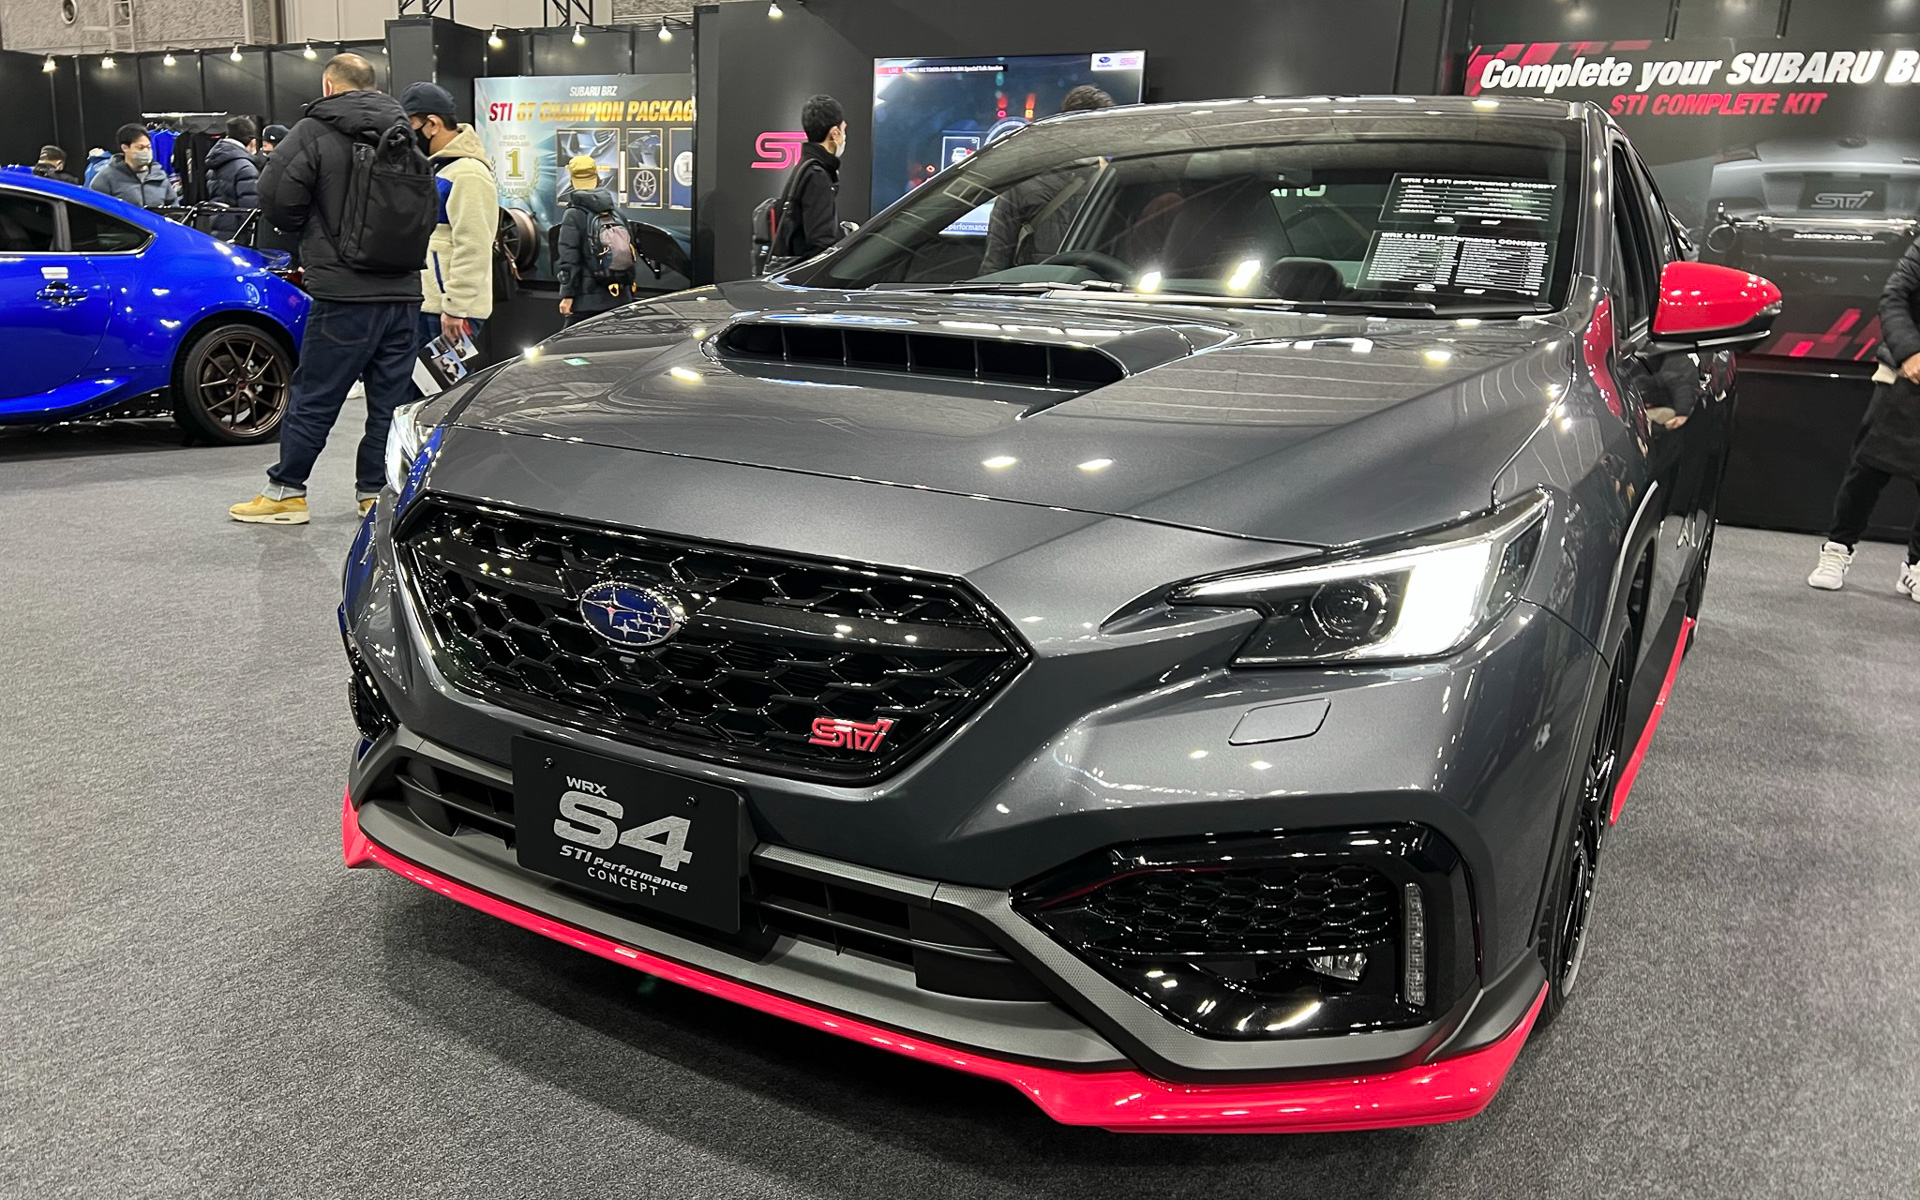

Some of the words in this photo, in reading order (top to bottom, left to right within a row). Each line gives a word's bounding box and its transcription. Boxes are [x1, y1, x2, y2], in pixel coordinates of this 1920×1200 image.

[1480, 56, 1633, 94] Complete
[1635, 59, 1723, 93] your
[1726, 50, 1884, 85] SUBARU
[569, 87, 600, 97] SUBARU
[602, 86, 618, 96] BRZ
[489, 103, 513, 121] STI
[517, 102, 539, 121] GT
[540, 101, 625, 121] CHAMPION
[1609, 94, 1650, 116] STI
[1652, 93, 1781, 115] COMPLETE
[1782, 92, 1829, 115] KIT
[506, 148, 524, 179] 1
[1511, 182, 1557, 190] CONCEPT
[1498, 238, 1547, 247] CONCEPT
[566, 775, 608, 797] WRX
[553, 790, 693, 872] S4
[559, 844, 592, 863] STI
[587, 866, 659, 896] CONCEPT
